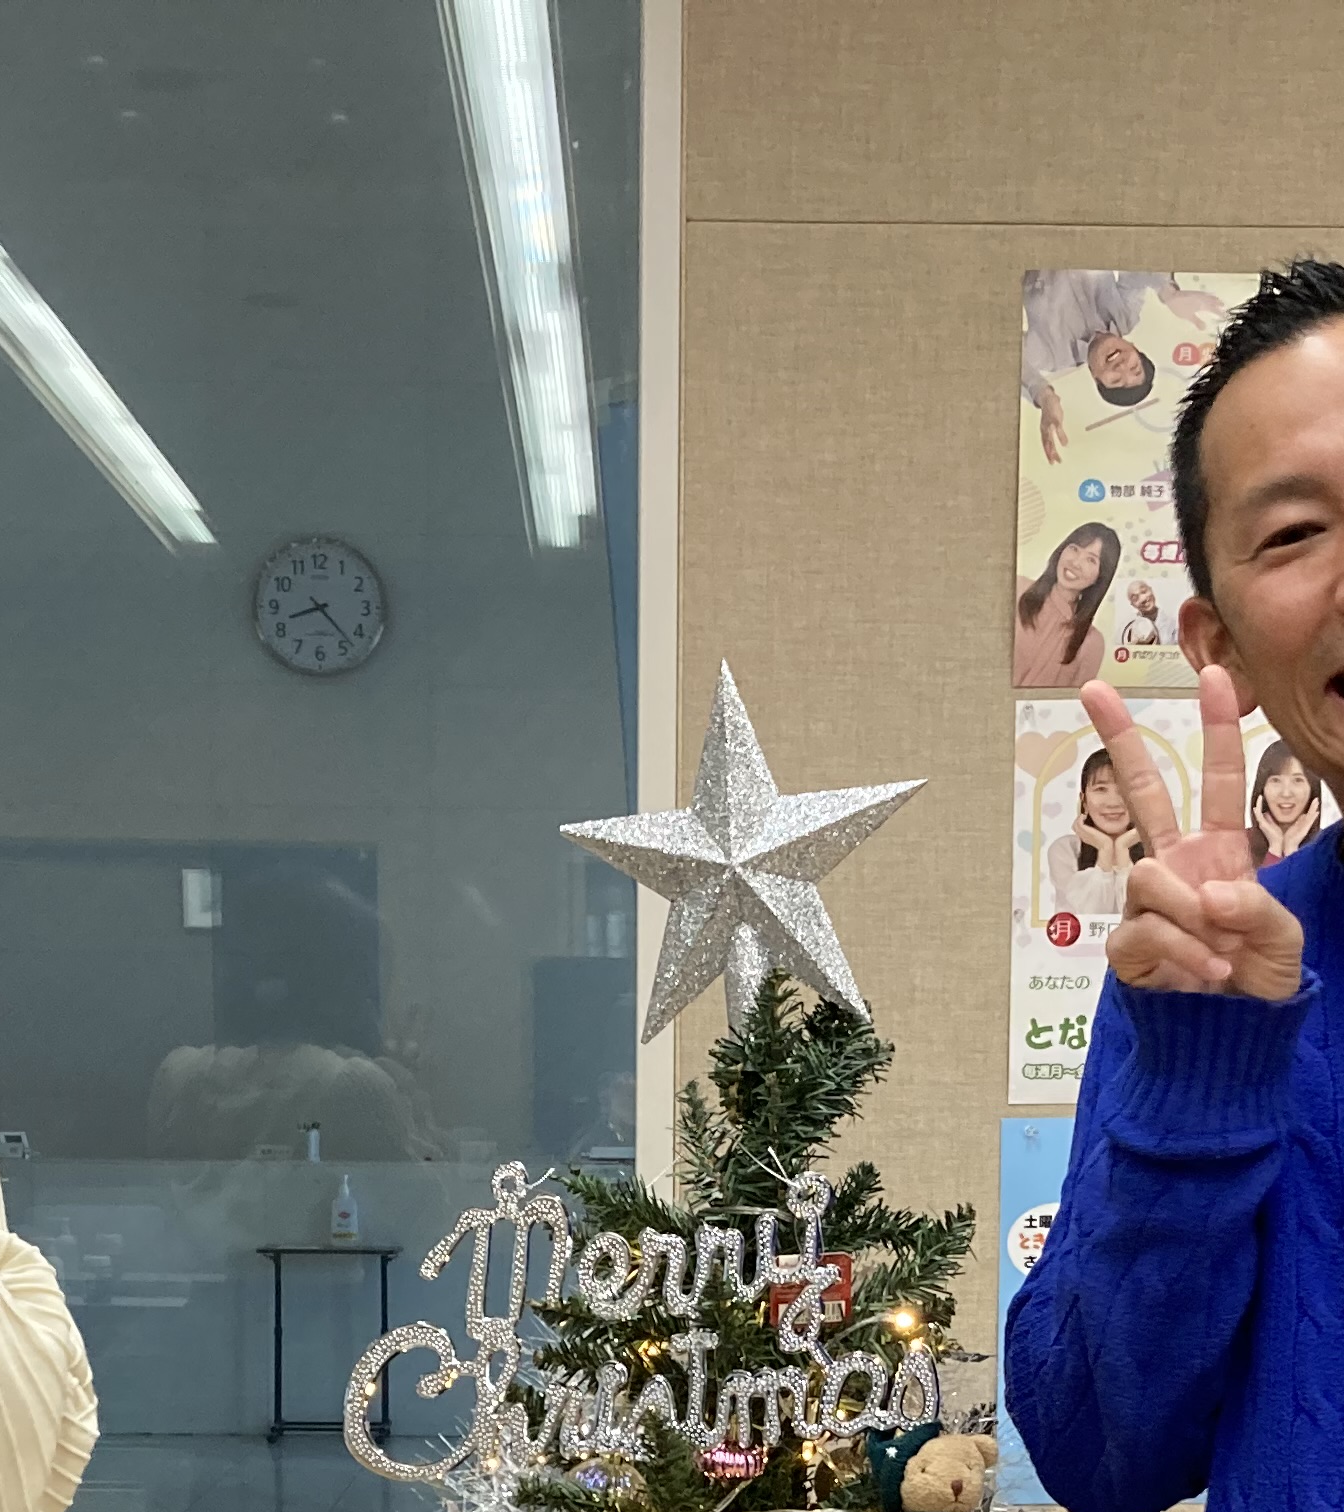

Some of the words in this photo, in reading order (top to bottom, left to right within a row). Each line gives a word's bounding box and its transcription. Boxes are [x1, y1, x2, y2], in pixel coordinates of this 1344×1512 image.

[1084, 483, 1100, 498] 水
[1110, 485, 1135, 498] 物部
[292, 560, 304, 575] 11
[311, 554, 328, 570] 12
[338, 560, 346, 575] 1
[274, 576, 291, 592] 10
[353, 576, 364, 592] 2
[268, 600, 279, 615] 9
[361, 601, 371, 616] 3
[275, 622, 287, 638] 8
[353, 623, 364, 638] 4
[293, 639, 303, 654] 7
[315, 646, 325, 661] 6
[337, 640, 348, 656] 5
[1053, 918, 1072, 941] 月
[1028, 975, 1091, 990] あなたの
[1025, 1014, 1088, 1050] とな
[418, 1180, 843, 1353] Merry
